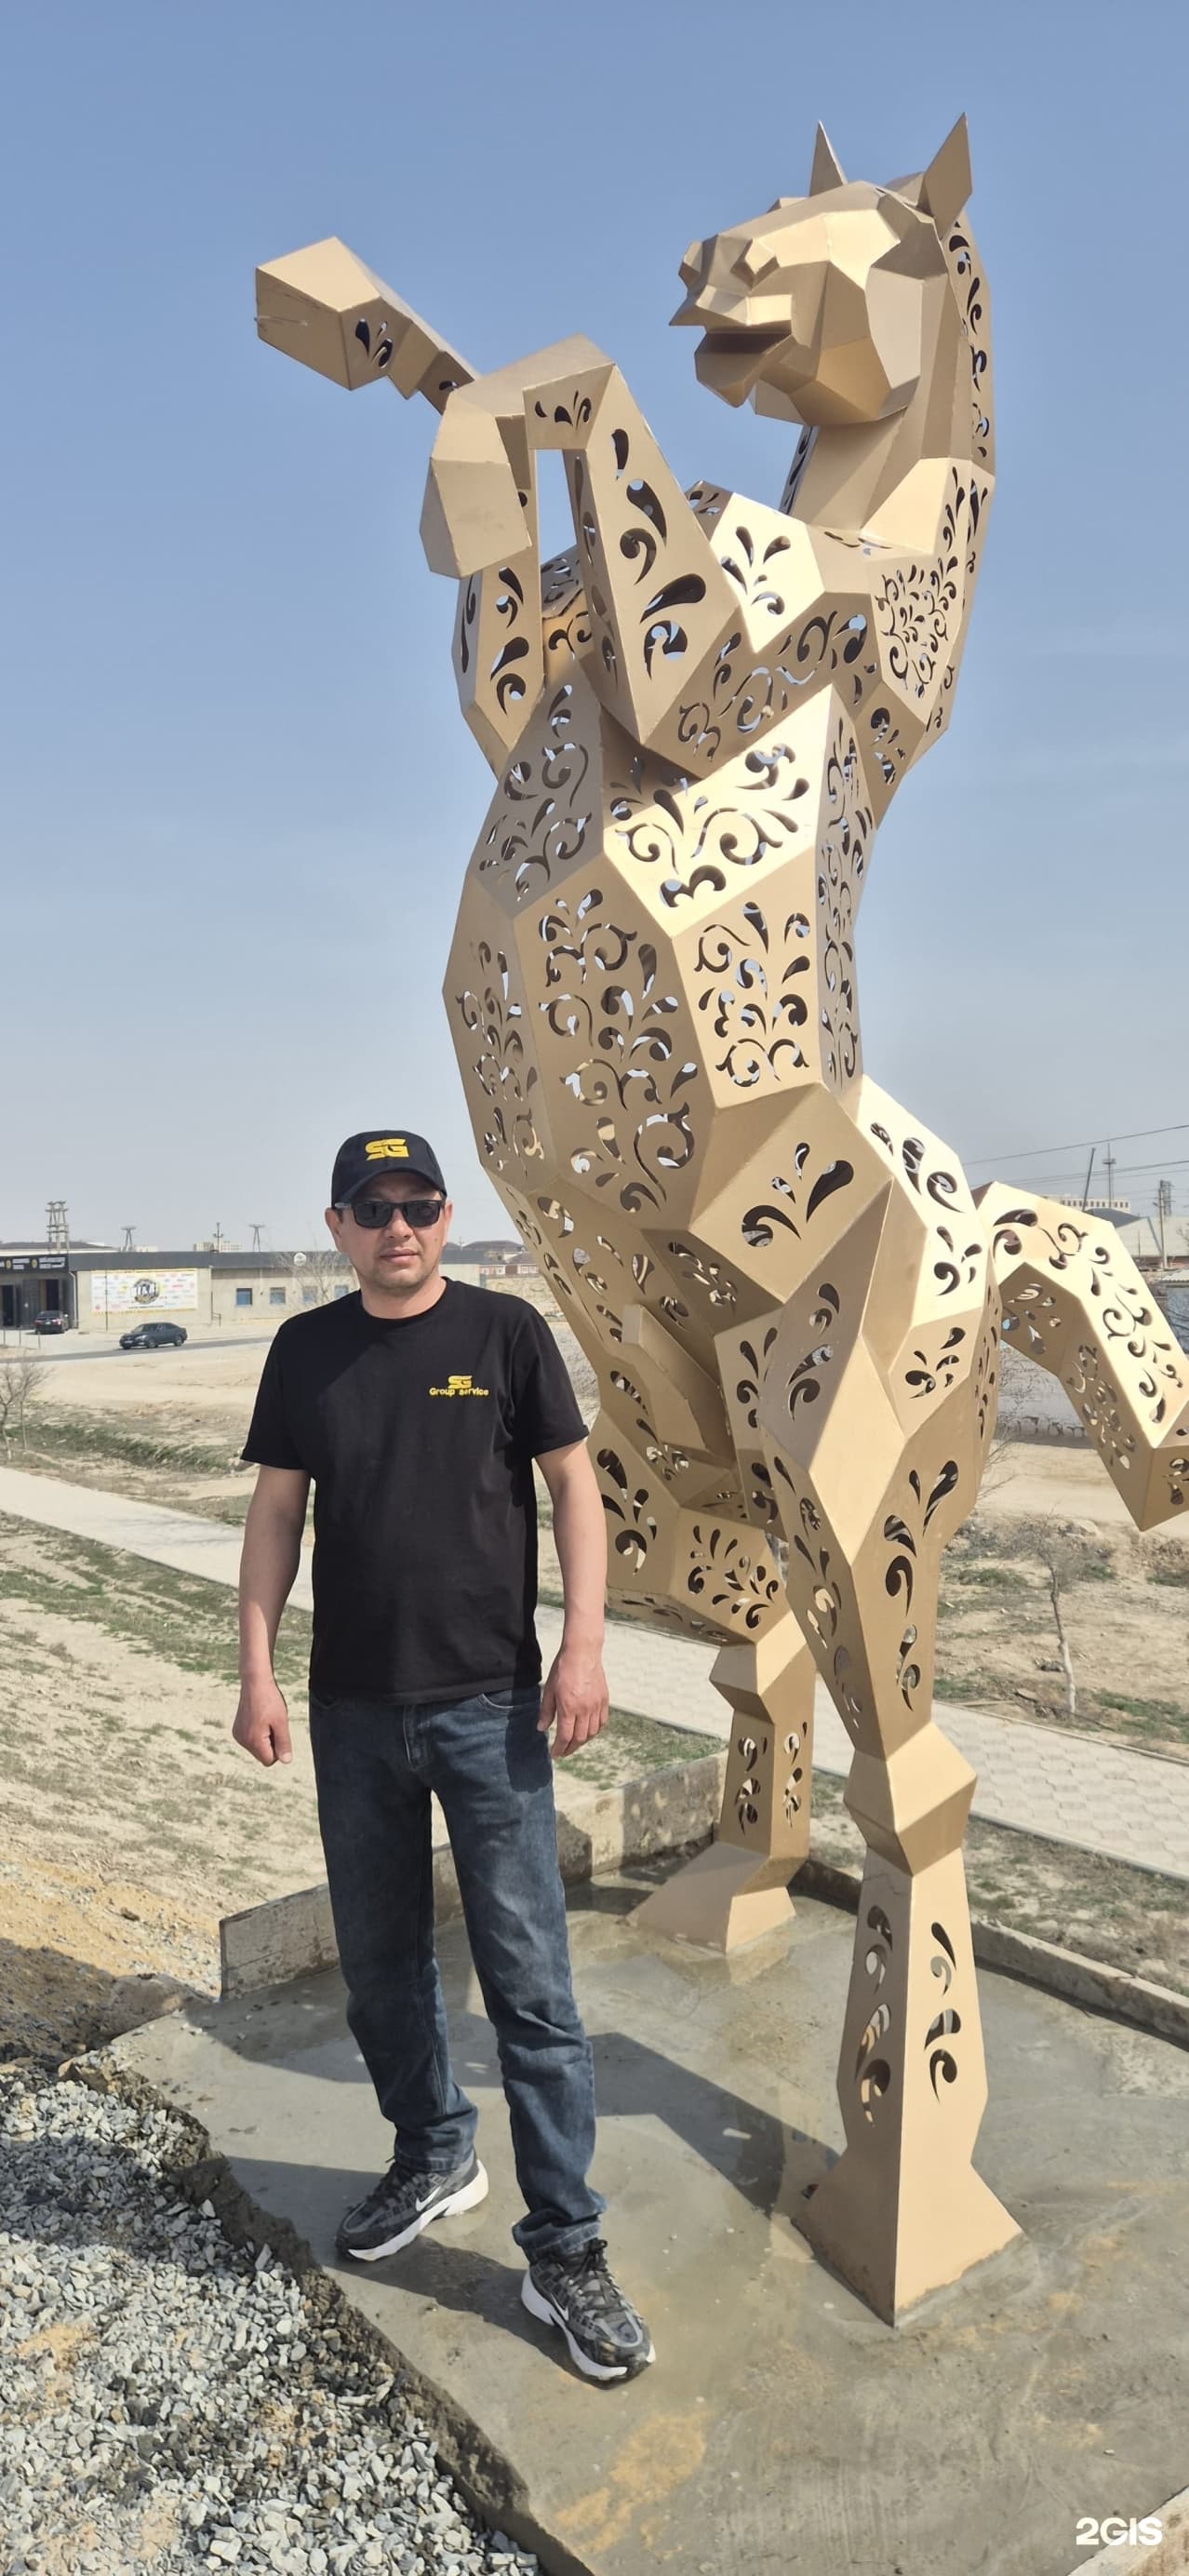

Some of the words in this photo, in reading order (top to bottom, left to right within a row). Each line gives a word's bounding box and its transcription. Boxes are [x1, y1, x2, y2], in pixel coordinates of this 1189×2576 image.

[365, 1138, 409, 1161] SG
[448, 1375, 473, 1389] SG
[429, 1388, 456, 1397] Group
[459, 1387, 489, 1396] service
